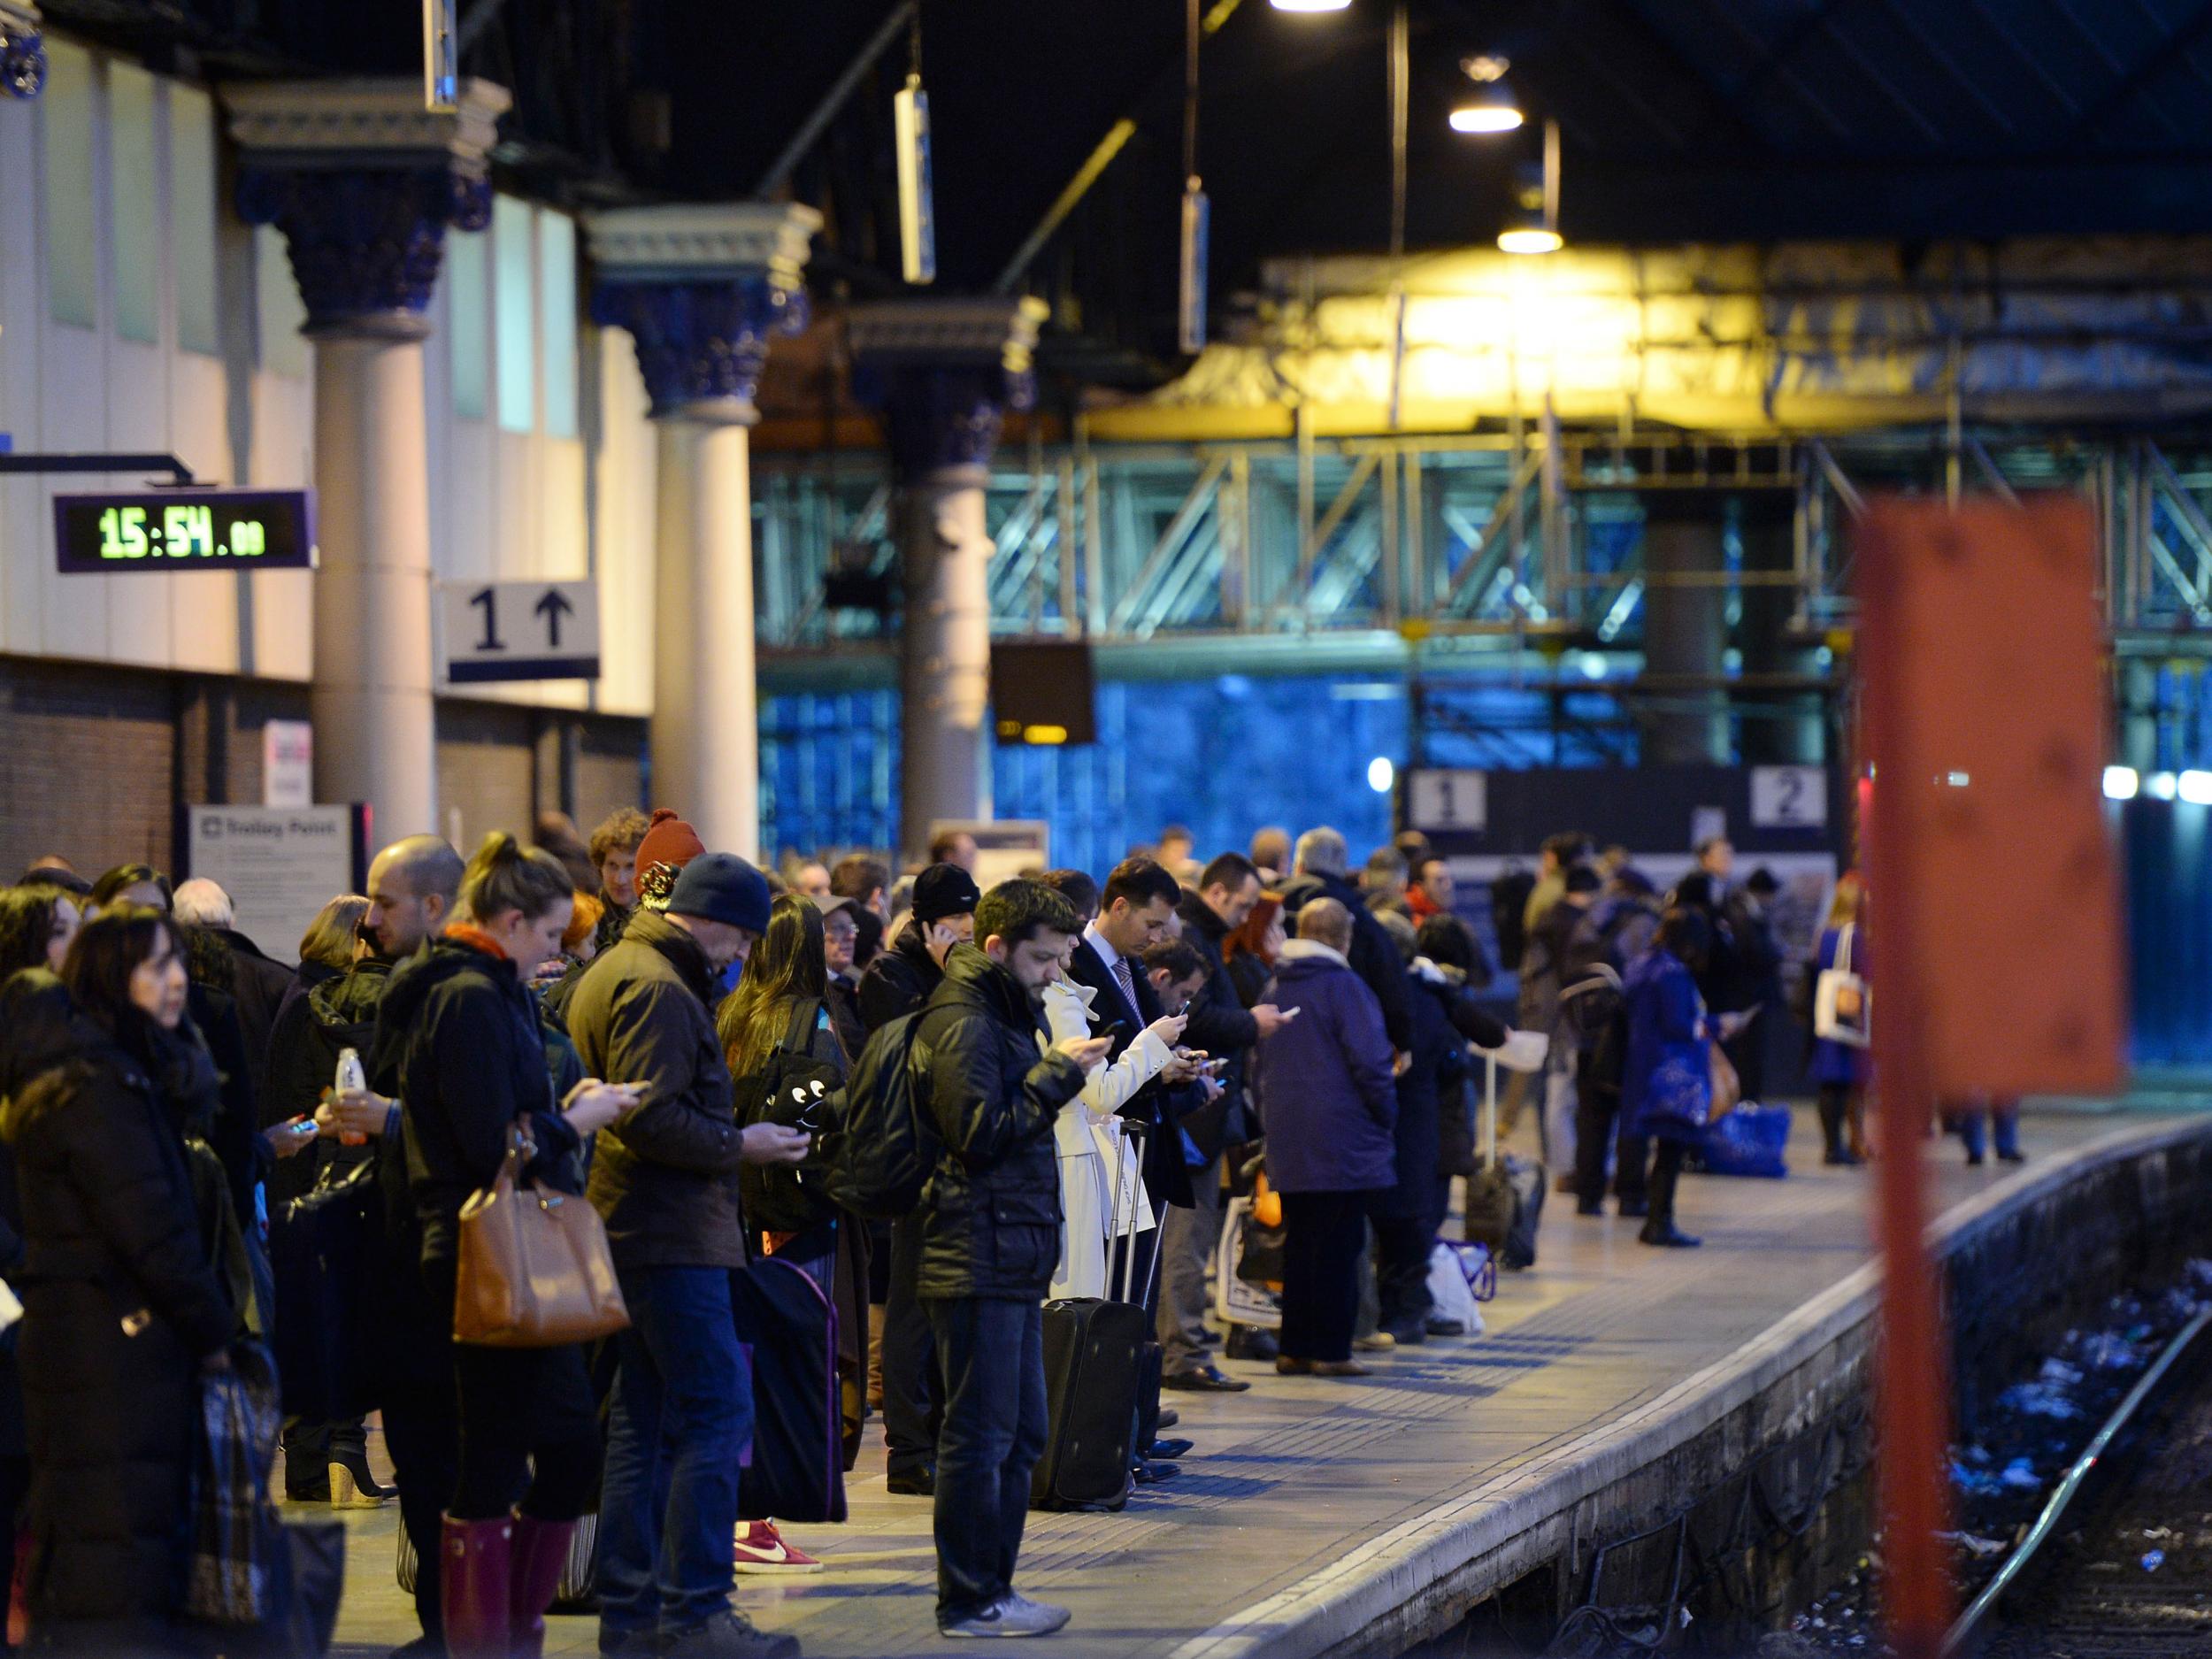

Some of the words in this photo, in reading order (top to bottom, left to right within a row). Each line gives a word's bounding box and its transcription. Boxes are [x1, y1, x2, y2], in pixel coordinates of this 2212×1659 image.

[470, 585, 508, 651] 1
[1436, 779, 1459, 823] 1
[1775, 772, 1803, 825] 2
